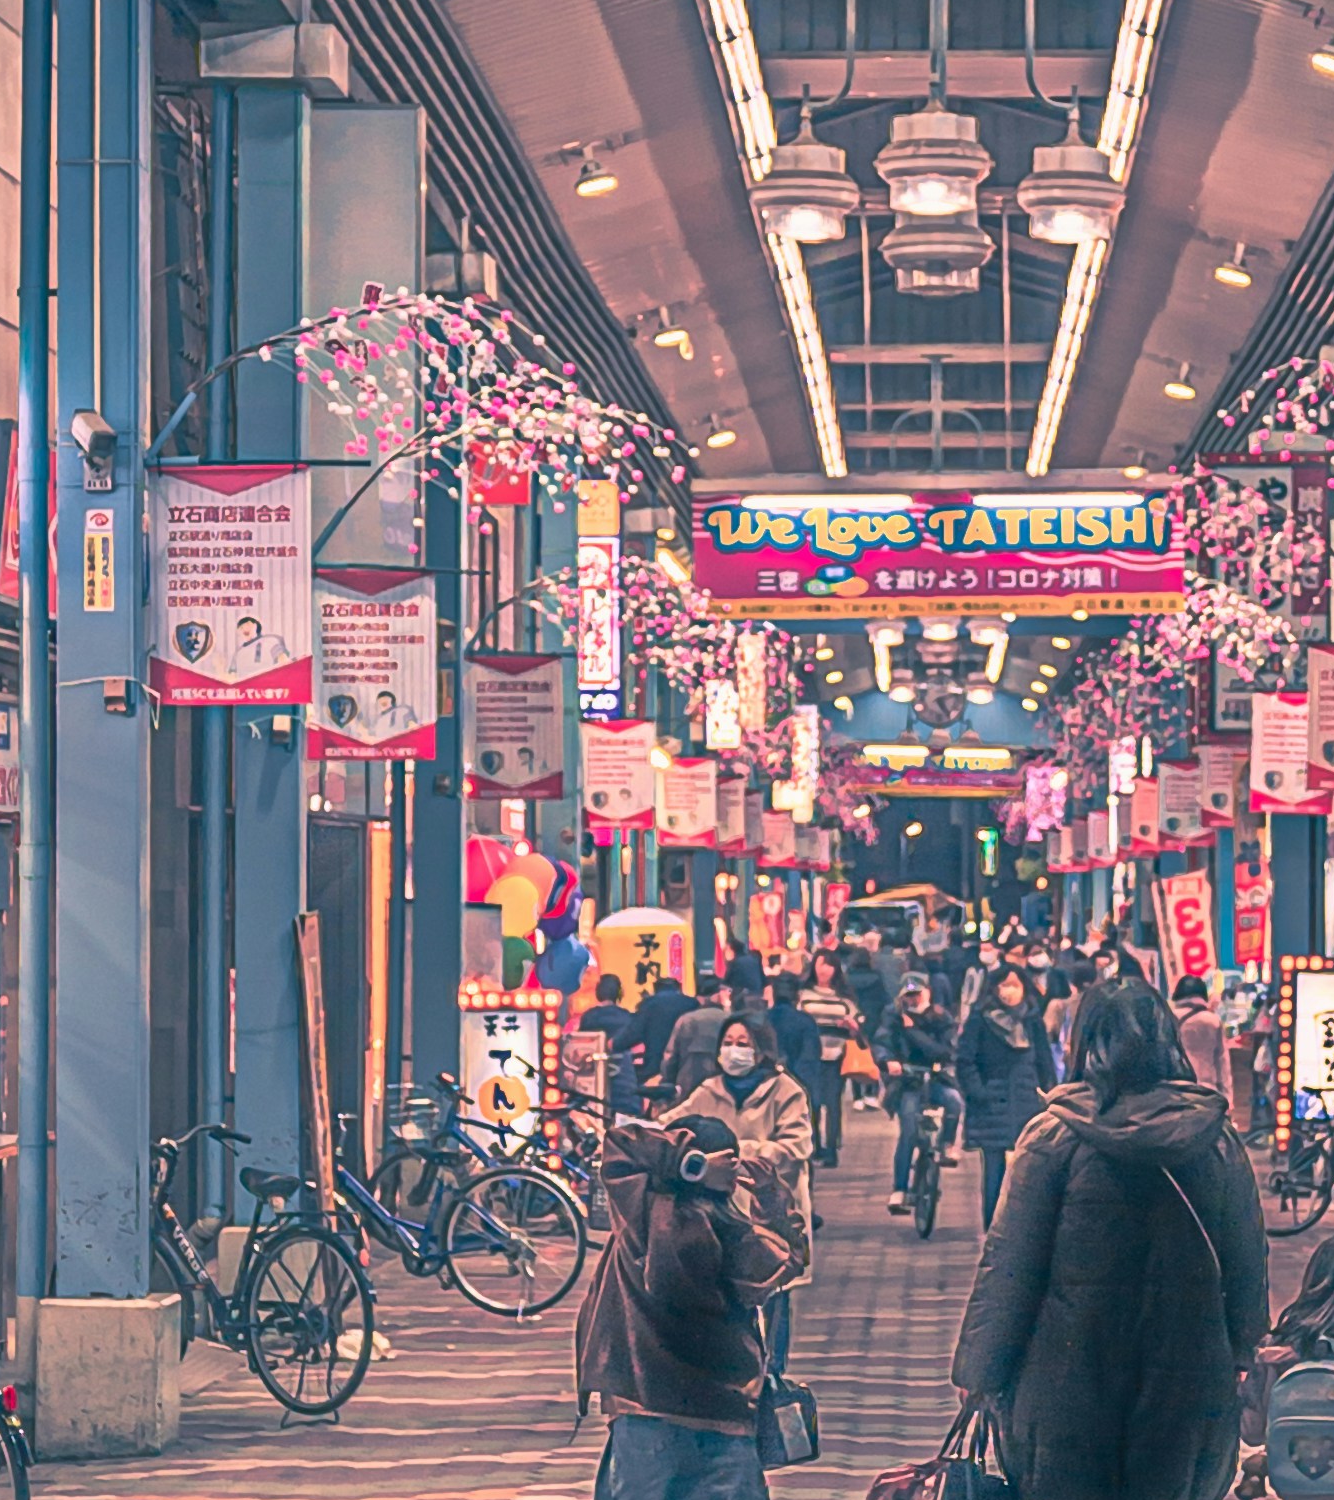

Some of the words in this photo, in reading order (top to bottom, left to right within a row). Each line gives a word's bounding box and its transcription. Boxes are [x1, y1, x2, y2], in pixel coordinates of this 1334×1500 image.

[167, 505, 291, 523] 立石商店連合会
[707, 507, 799, 546] We
[801, 507, 916, 556] Love
[757, 571, 799, 592] 三密
